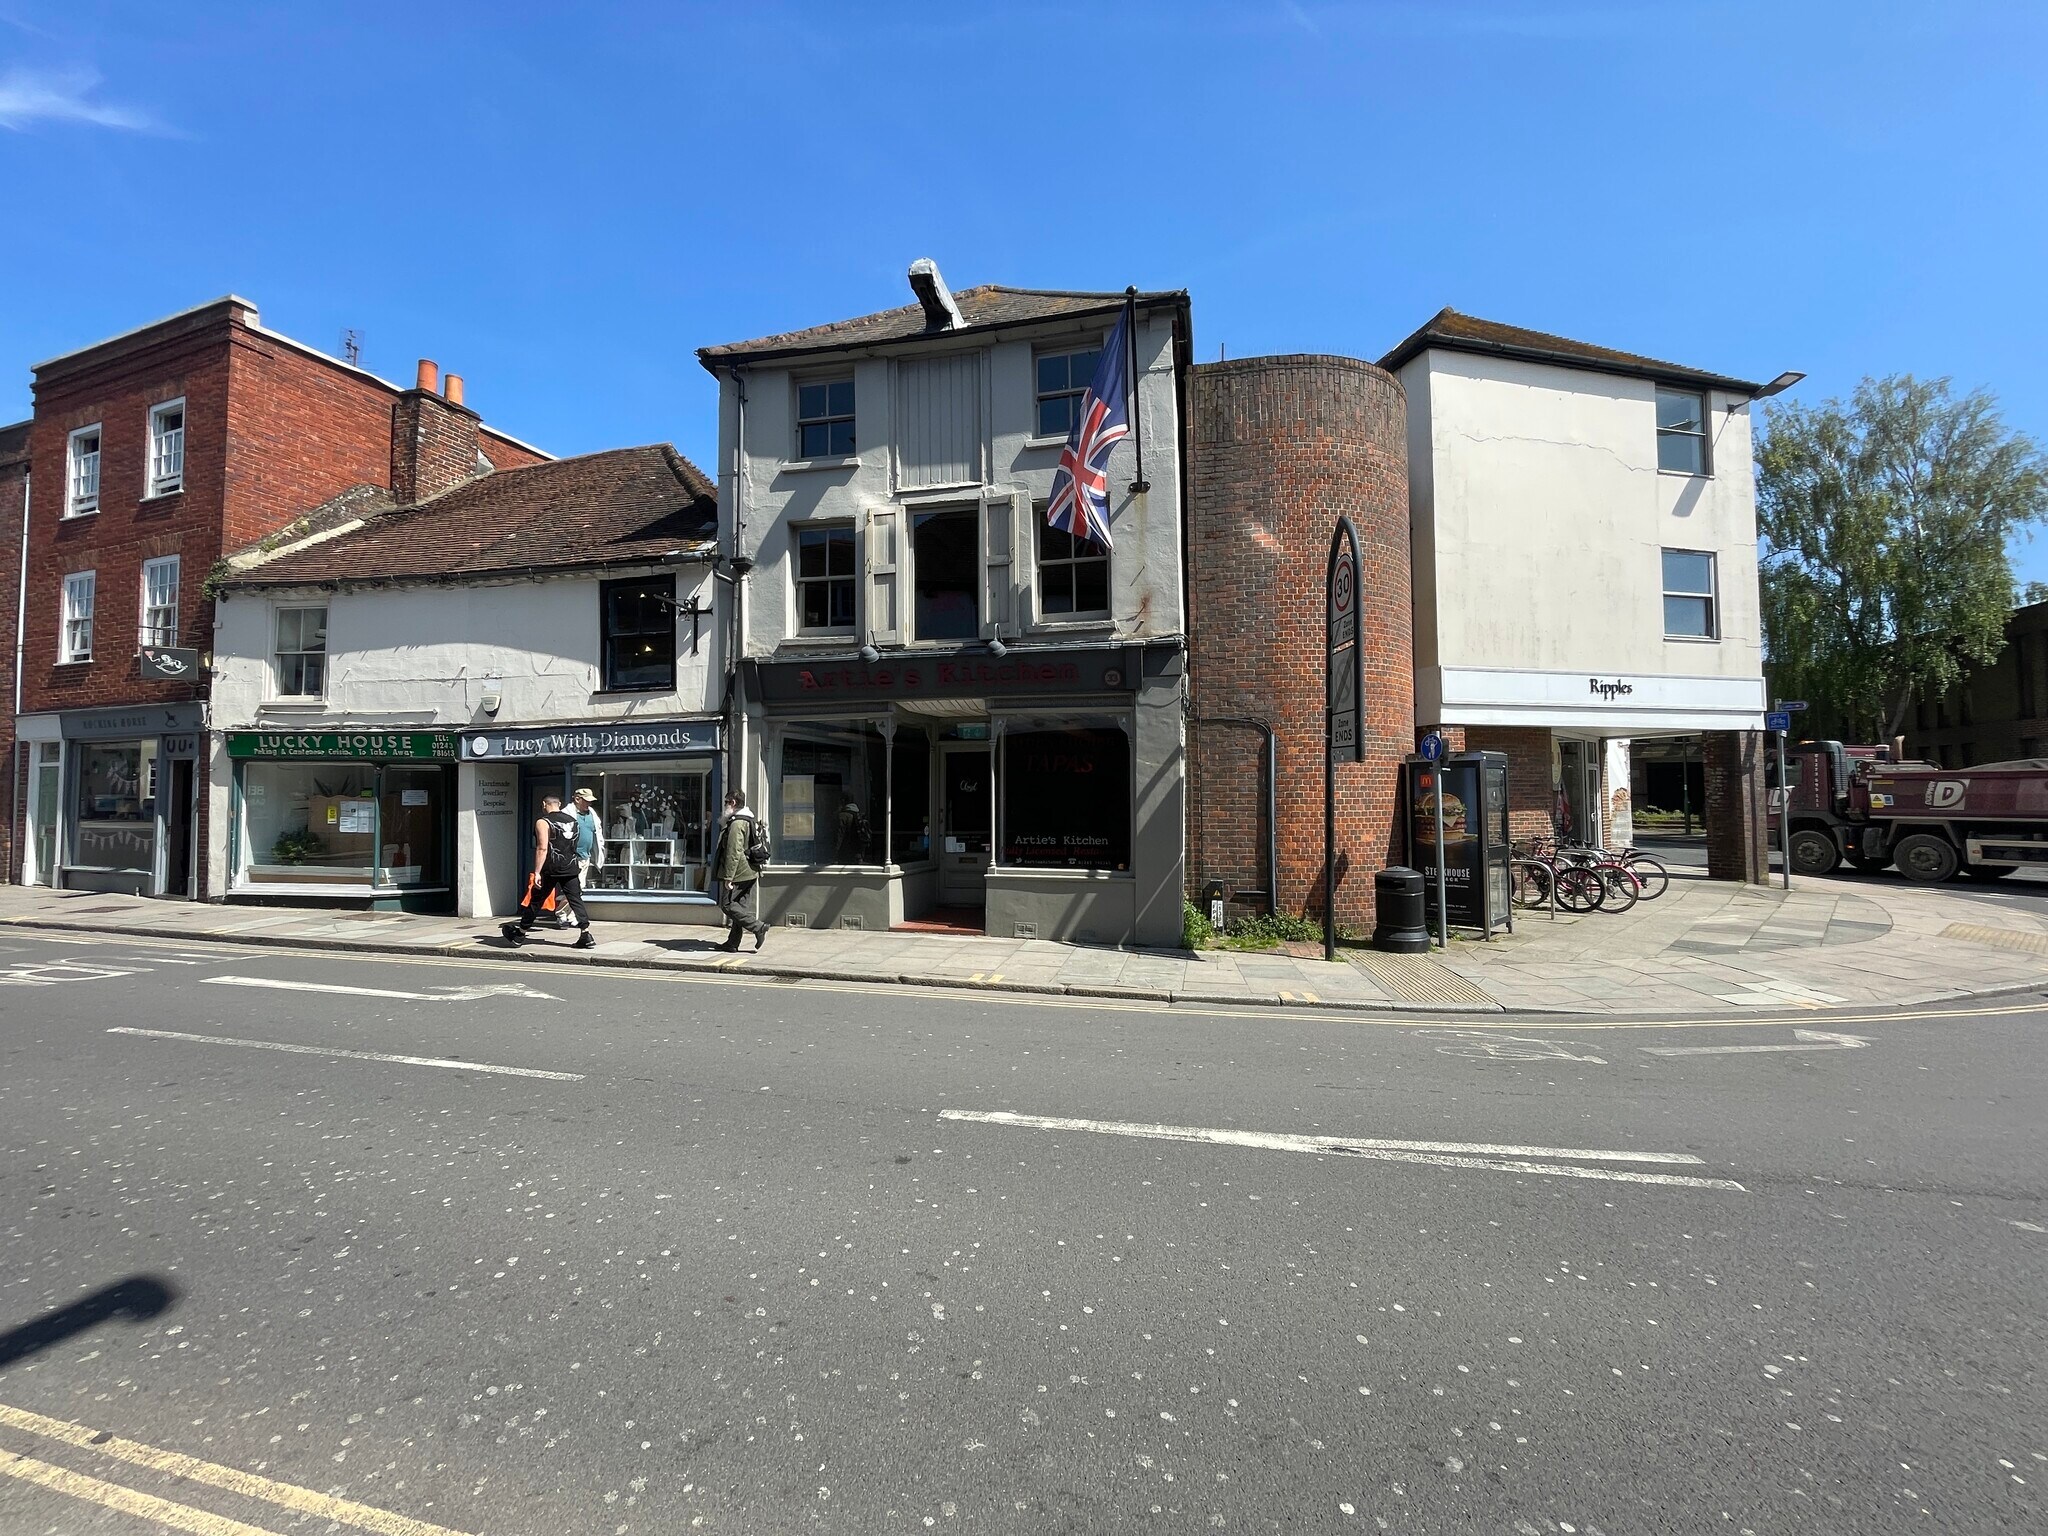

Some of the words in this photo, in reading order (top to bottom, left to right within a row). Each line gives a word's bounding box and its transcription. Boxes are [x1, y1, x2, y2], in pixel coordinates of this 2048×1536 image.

[1336, 573, 1350, 598] 30
[1342, 626, 1354, 639] ENDS
[799, 664, 922, 690] Artie's
[936, 659, 1080, 687] Kitchen
[1589, 678, 1633, 700] Ripples
[1338, 719, 1349, 728] Zone
[259, 735, 323, 748] LUCKY
[337, 735, 412, 749] HOUSE
[504, 736, 544, 754] Lucy
[550, 732, 593, 749] With
[600, 729, 691, 747] Diamonds
[1335, 729, 1352, 742] ENDS
[392, 749, 415, 757] Away
[1025, 752, 1096, 775] TAPAS
[482, 788, 508, 798] Jewellery
[483, 800, 506, 808] Bespoke
[1015, 835, 1056, 845] Artie's
[1063, 835, 1109, 845] Kitchen
